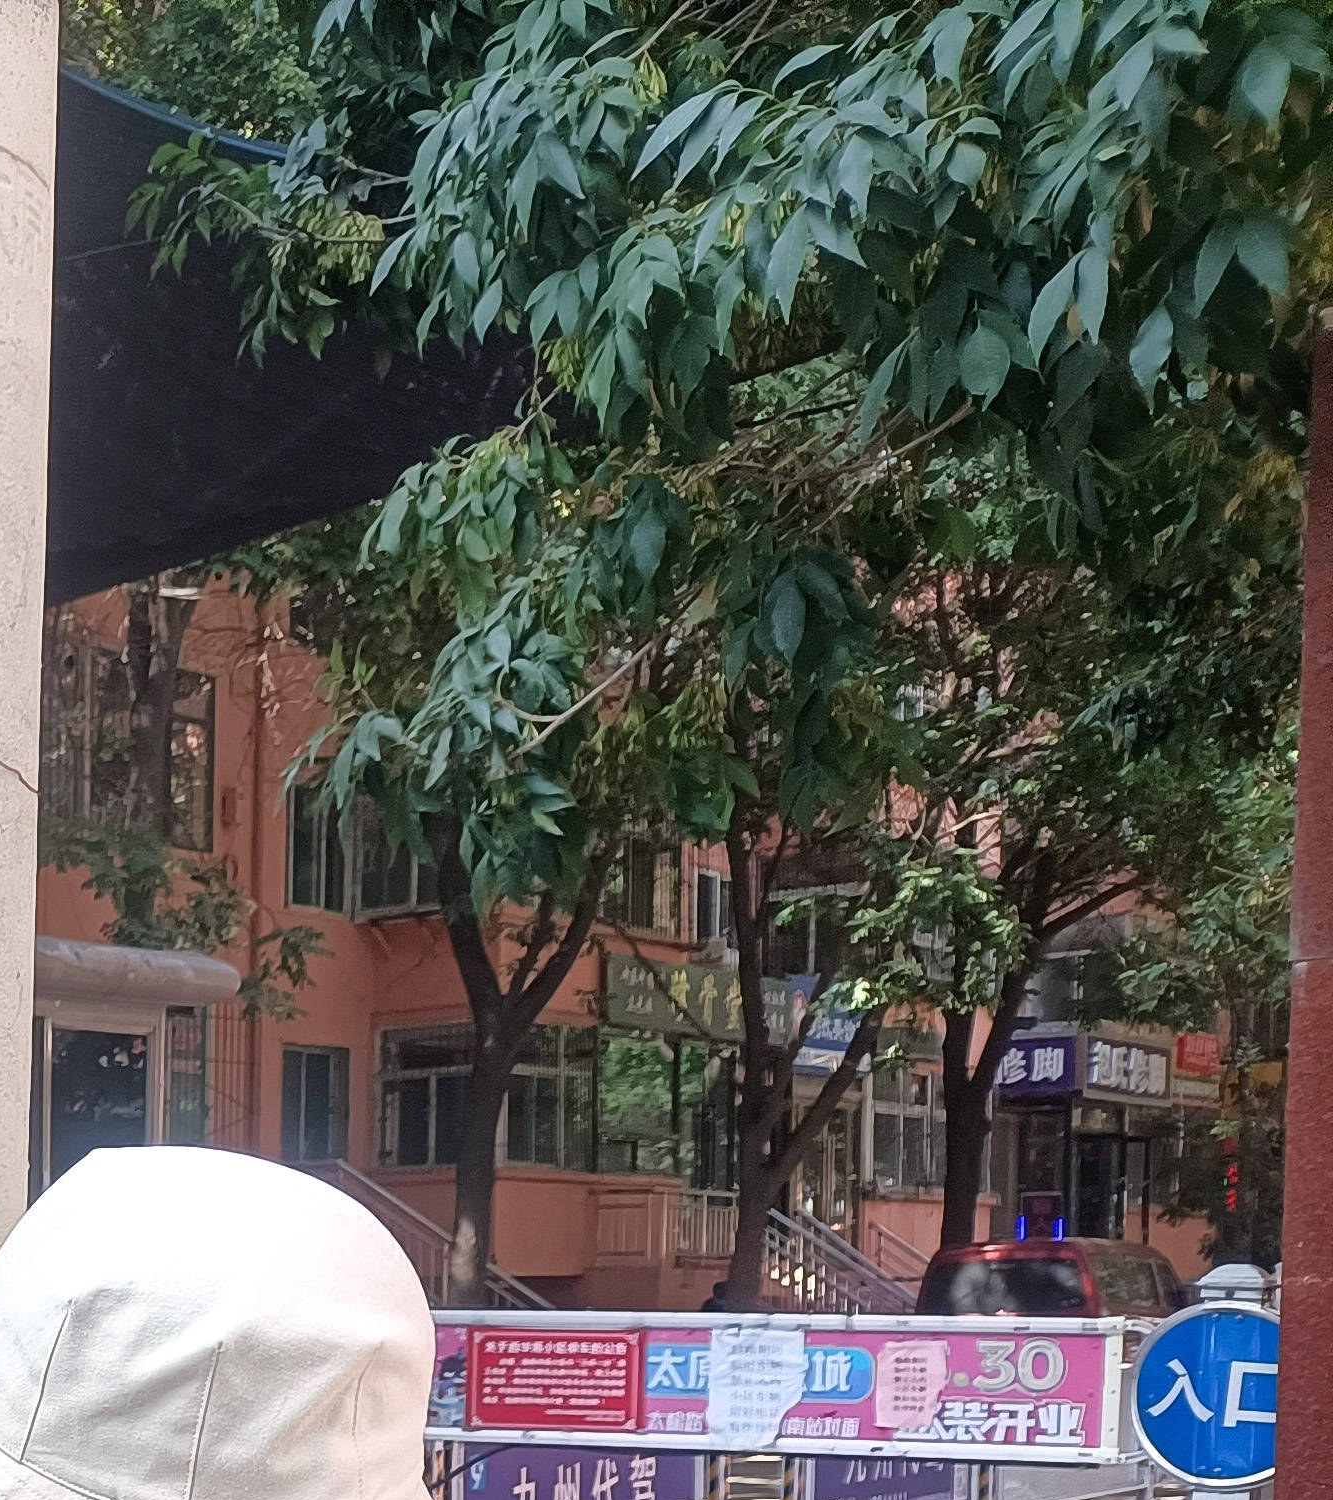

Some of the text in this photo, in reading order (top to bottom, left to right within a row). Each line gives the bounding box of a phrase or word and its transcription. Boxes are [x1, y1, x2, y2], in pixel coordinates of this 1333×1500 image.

[947, 1337, 1068, 1393] .30
[1147, 1357, 1278, 1428] 入口
[782, 1416, 861, 1438] 南站对面
